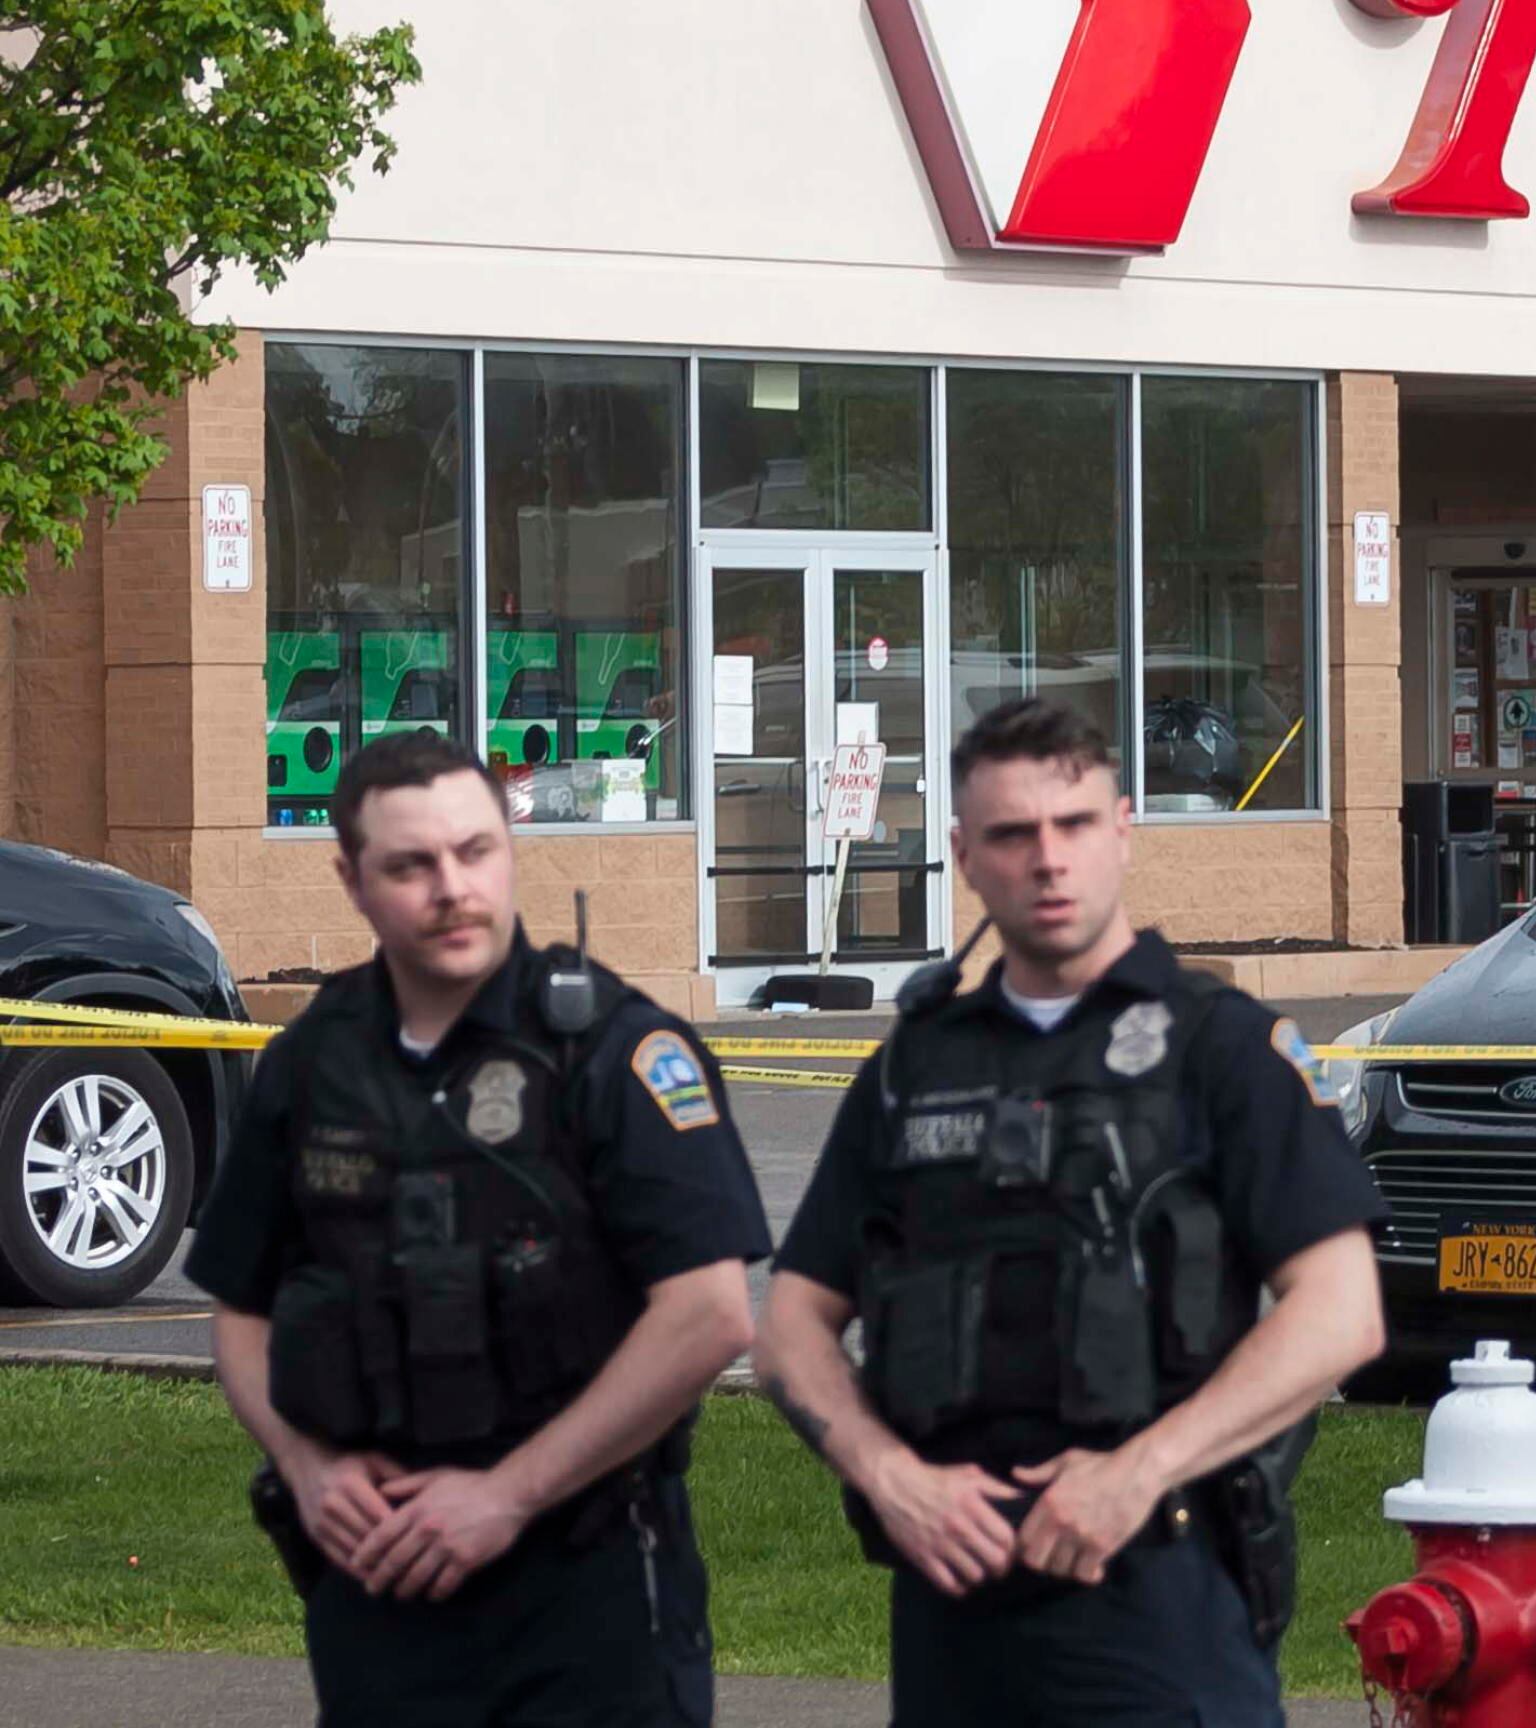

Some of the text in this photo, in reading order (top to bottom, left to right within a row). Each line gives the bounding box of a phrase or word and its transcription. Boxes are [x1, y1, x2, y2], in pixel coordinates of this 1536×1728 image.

[218, 496, 236, 515] NO
[207, 519, 248, 538] PARKING
[216, 556, 240, 568] LANE
[848, 752, 868, 770] NO
[834, 773, 879, 790] PARKING
[842, 792, 863, 804] FIRE
[838, 806, 863, 819] LANE
[1473, 1224, 1536, 1236] NEW YORK
[1453, 1241, 1488, 1278] JRY
